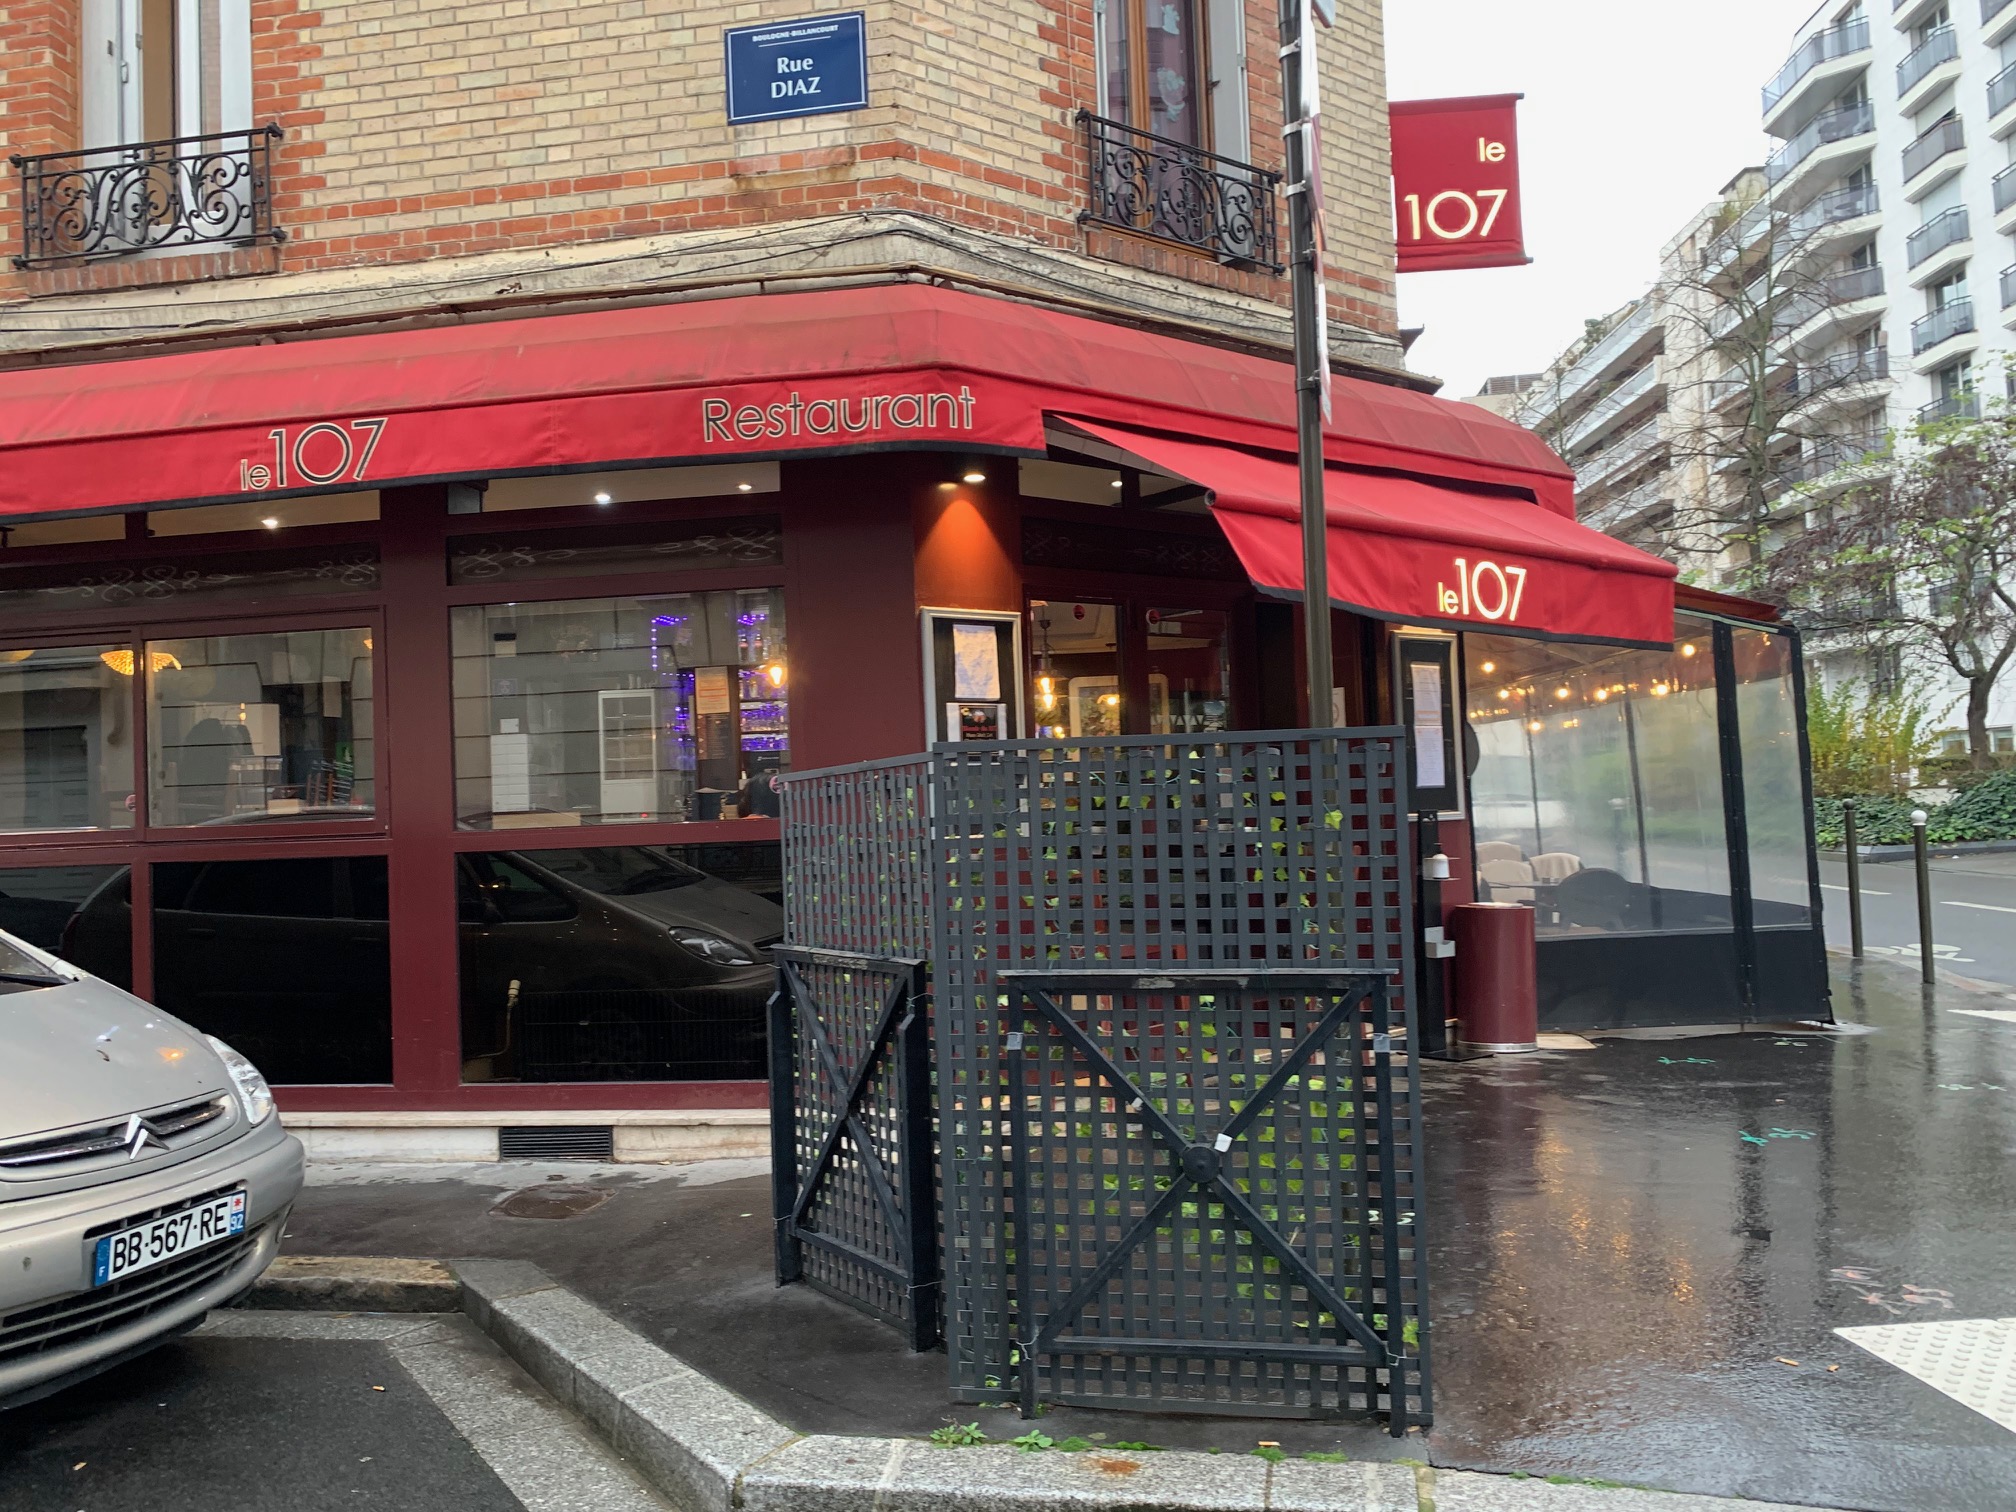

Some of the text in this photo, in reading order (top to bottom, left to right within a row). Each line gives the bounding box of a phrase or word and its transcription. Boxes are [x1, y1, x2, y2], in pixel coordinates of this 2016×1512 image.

[752, 24, 839, 42] BOULOGNE-BILLANCOURT
[777, 57, 814, 74] Rue
[770, 76, 821, 98] DIAZ
[1478, 137, 1506, 162] le
[1404, 189, 1508, 240] 107
[702, 385, 976, 442] Restaurant
[98, 1265, 107, 1278] F
[230, 1213, 244, 1231] 92
